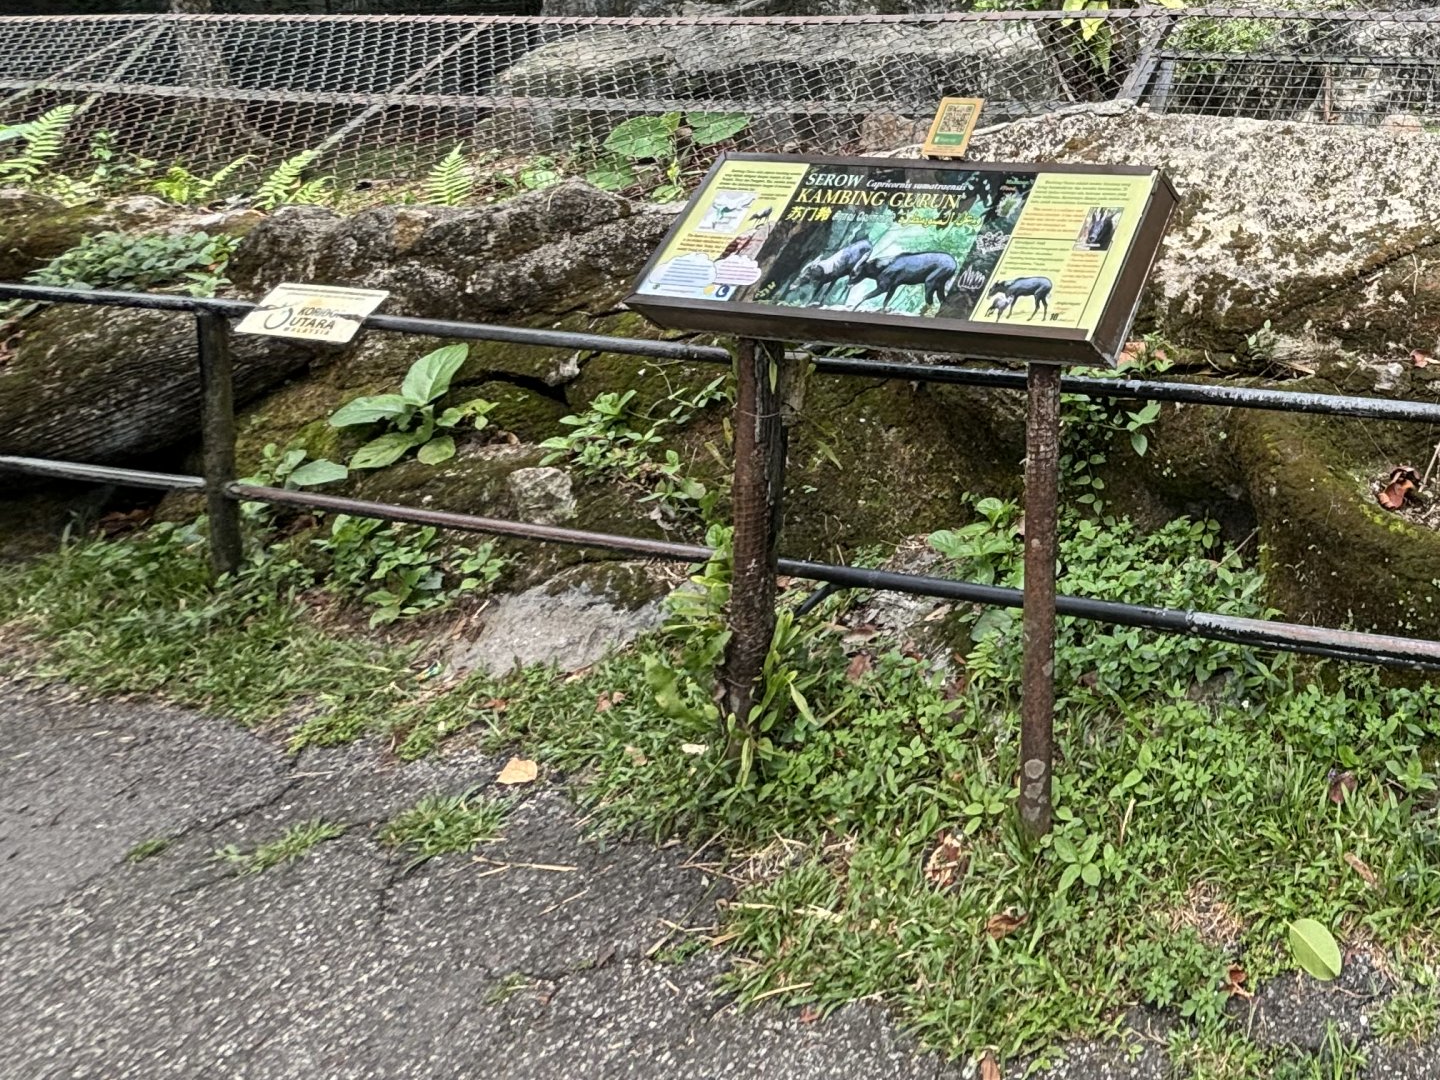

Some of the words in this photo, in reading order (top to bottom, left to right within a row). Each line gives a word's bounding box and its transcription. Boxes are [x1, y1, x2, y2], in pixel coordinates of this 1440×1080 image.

[805, 172, 864, 187] SEROW
[866, 179, 912, 191] Capricornis
[795, 188, 885, 207] KAMBING
[889, 192, 963, 210] GURUN
[289, 317, 336, 331] UTARA
